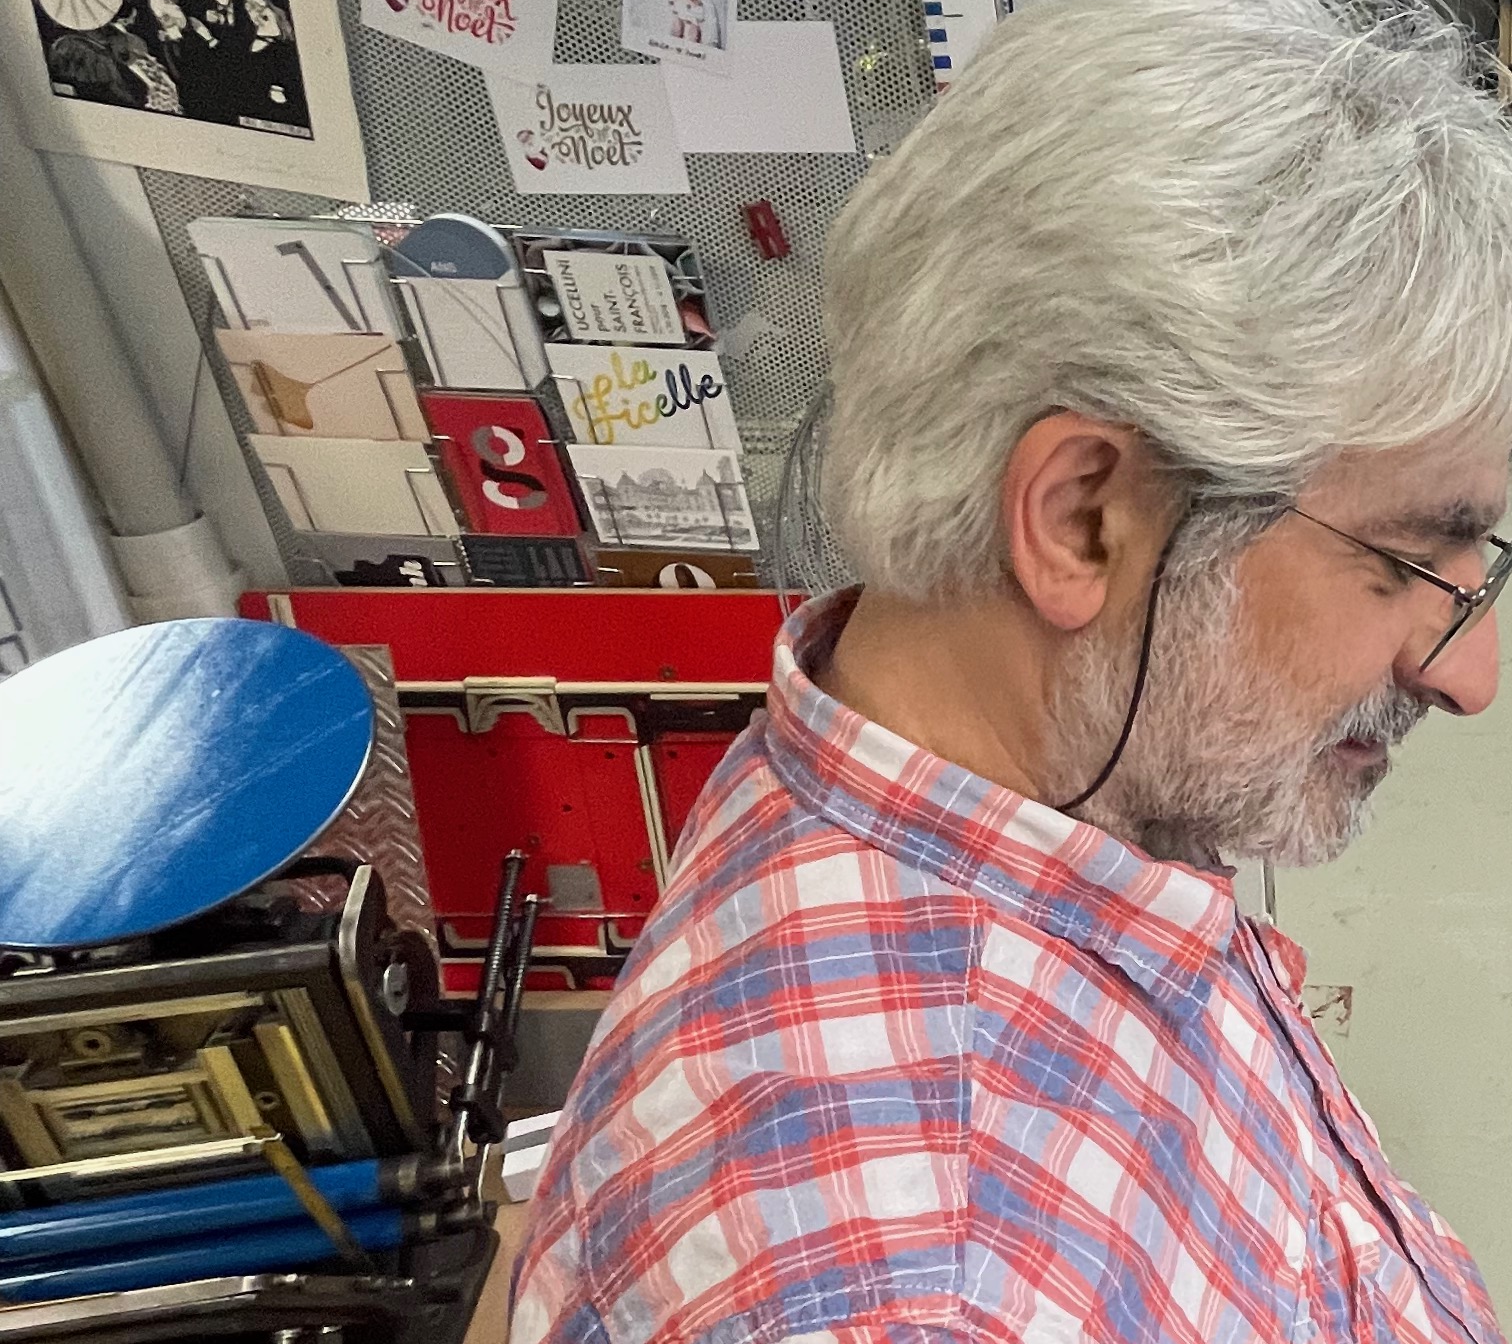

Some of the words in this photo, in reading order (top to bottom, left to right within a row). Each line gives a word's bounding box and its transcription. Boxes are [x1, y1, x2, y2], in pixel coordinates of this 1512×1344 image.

[535, 83, 642, 138] Joyeux
[556, 258, 590, 332] UCCELLINI
[614, 263, 648, 334] FRANÇOIS
